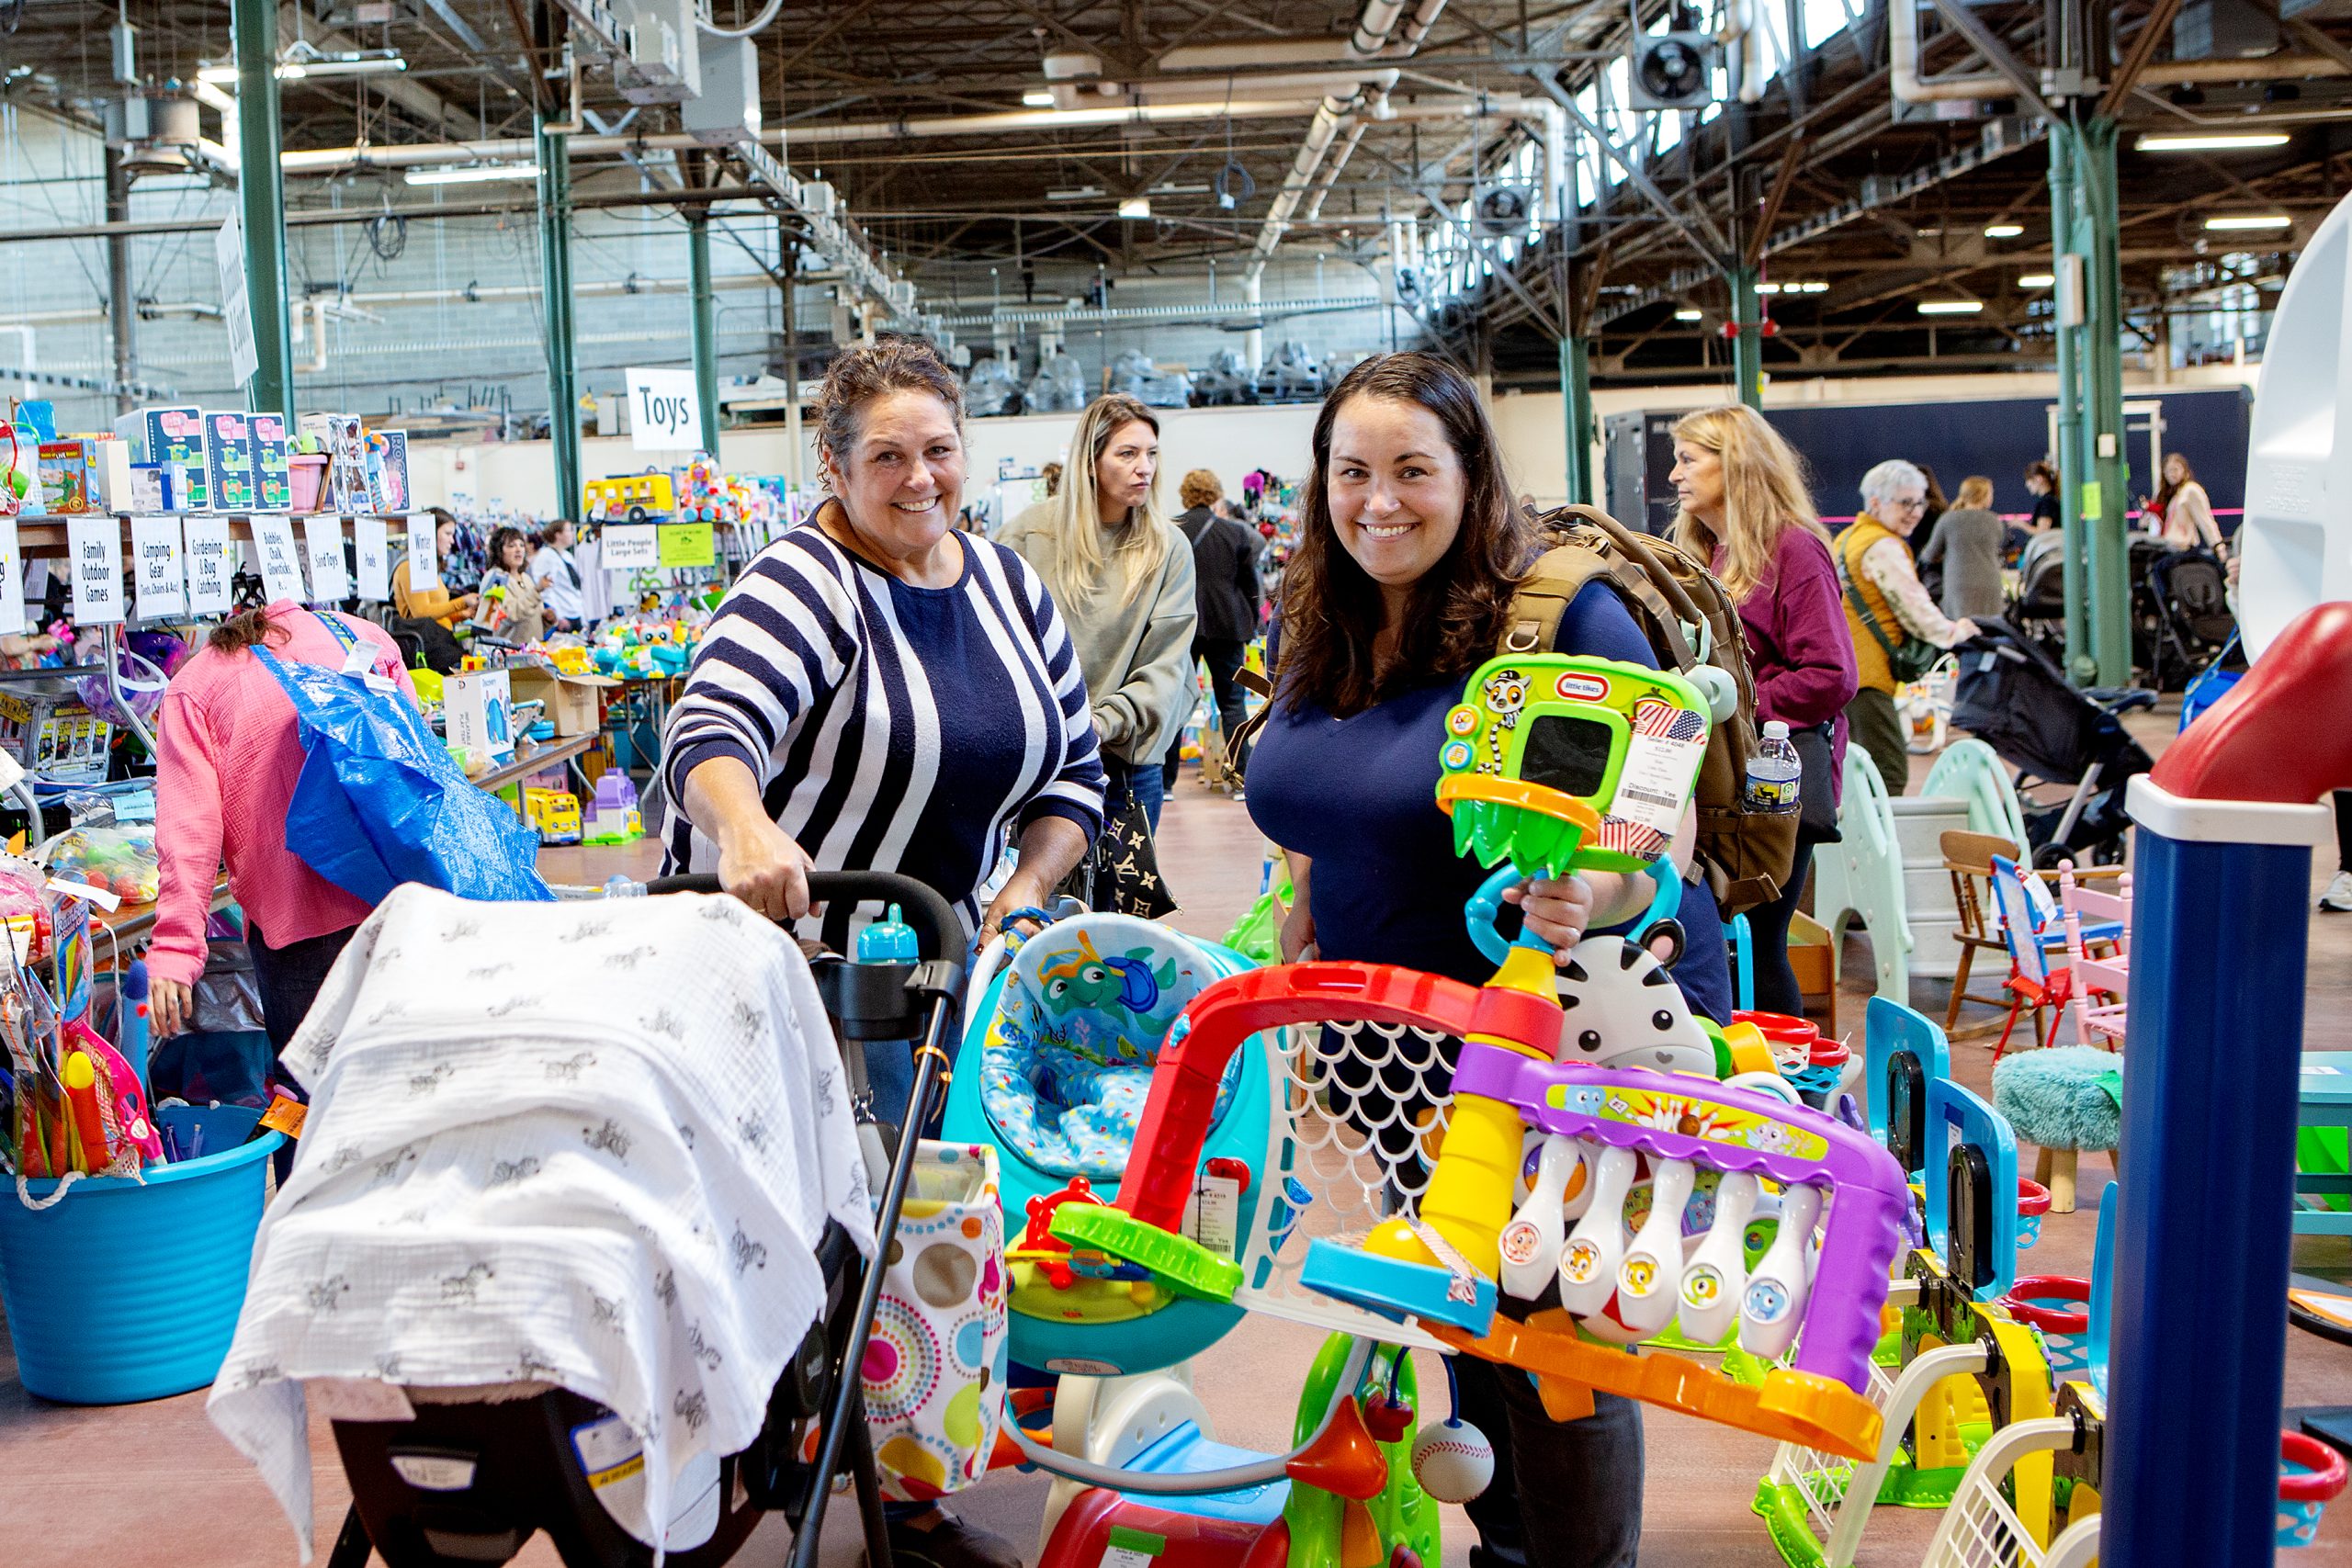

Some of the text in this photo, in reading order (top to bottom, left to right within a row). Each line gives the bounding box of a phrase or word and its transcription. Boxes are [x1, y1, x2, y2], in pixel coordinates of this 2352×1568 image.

[639, 386, 689, 435] Toys
[193, 538, 222, 558] Gardening
[414, 533, 431, 550] Winter
[606, 539, 652, 547] Little People
[83, 541, 106, 563] Family
[142, 540, 171, 562] Camping
[204, 558, 217, 578] Bug
[315, 552, 338, 570] Sand Toys
[420, 554, 428, 571] Fun
[82, 562, 109, 581] Outdoor
[149, 562, 164, 579] Gear
[85, 584, 108, 603] Games
[152, 582, 165, 595] Chairs
[197, 578, 221, 597] Catching
[1566, 682, 1581, 691] little
[1628, 782, 1660, 795] Discount:
[1664, 790, 1677, 798] Yes
